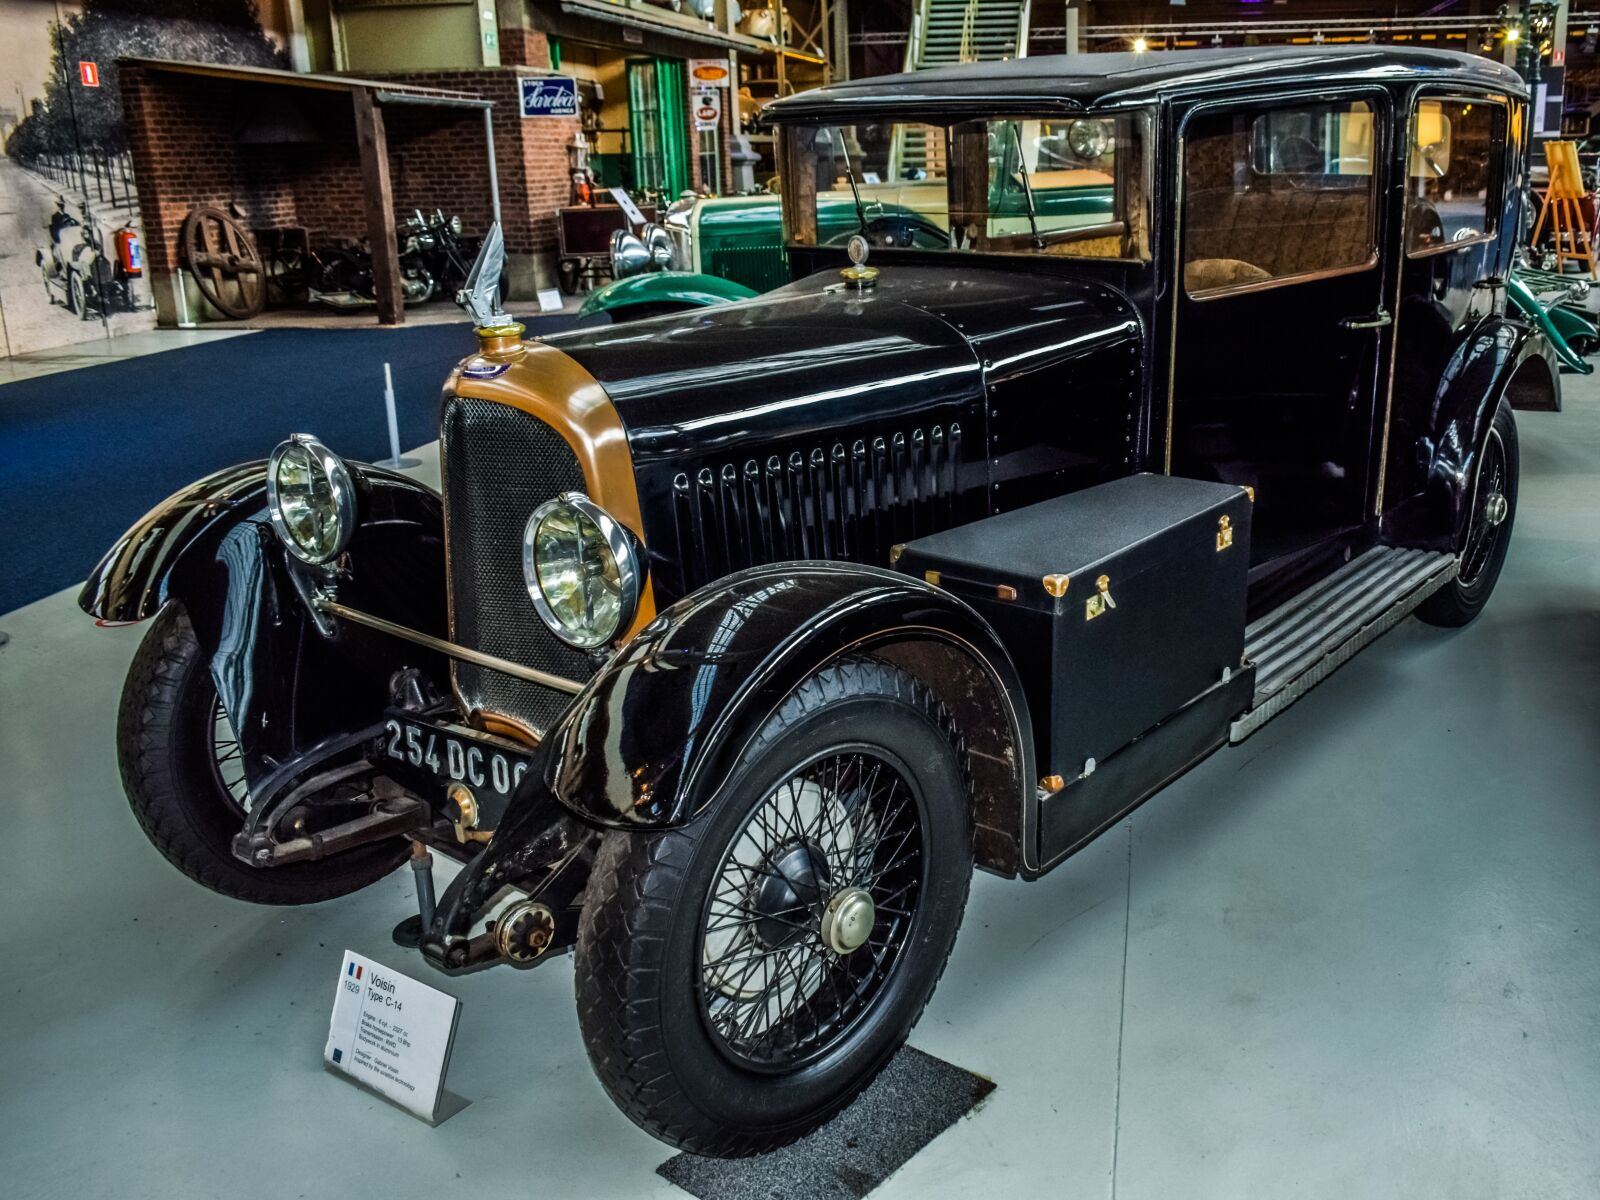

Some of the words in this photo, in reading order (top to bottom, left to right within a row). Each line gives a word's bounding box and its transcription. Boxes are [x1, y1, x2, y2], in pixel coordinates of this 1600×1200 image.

[386, 719, 440, 774] 254
[446, 739, 485, 787] DC
[344, 980, 360, 994] 1929
[371, 972, 395, 994] Voisin
[368, 987, 383, 1003] Type
[385, 996, 402, 1011] C-14
